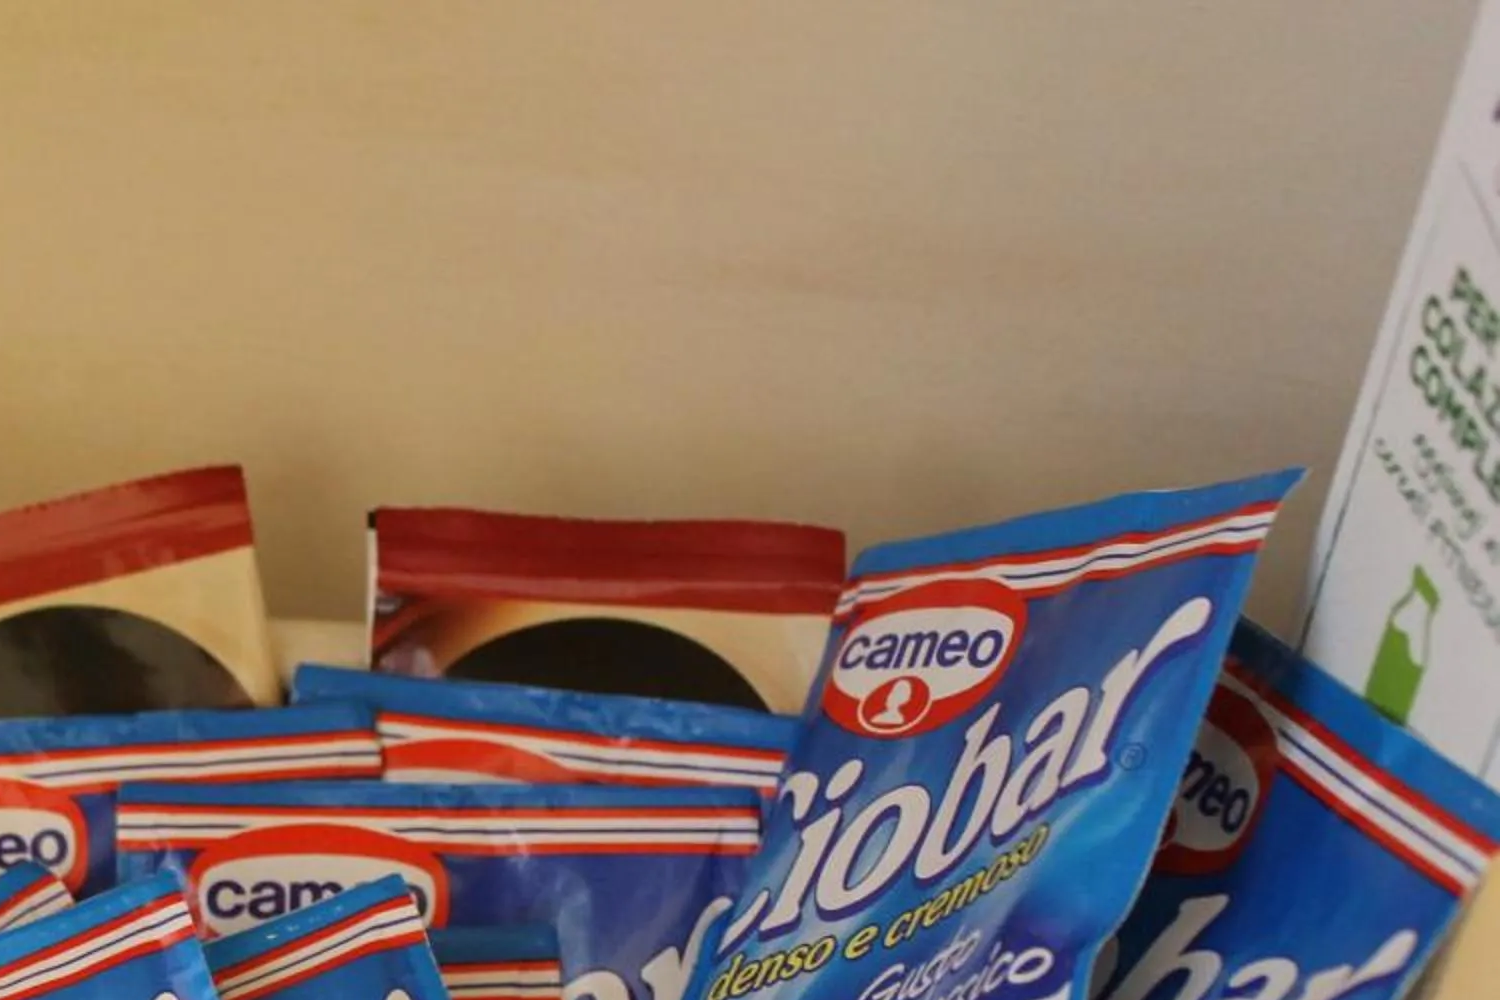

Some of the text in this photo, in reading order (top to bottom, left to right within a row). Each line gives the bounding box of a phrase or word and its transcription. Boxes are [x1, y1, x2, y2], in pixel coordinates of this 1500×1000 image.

[839, 628, 1004, 670] cameo
[205, 878, 428, 920] camo
[842, 924, 879, 960] e
[883, 823, 1050, 949] cremoso
